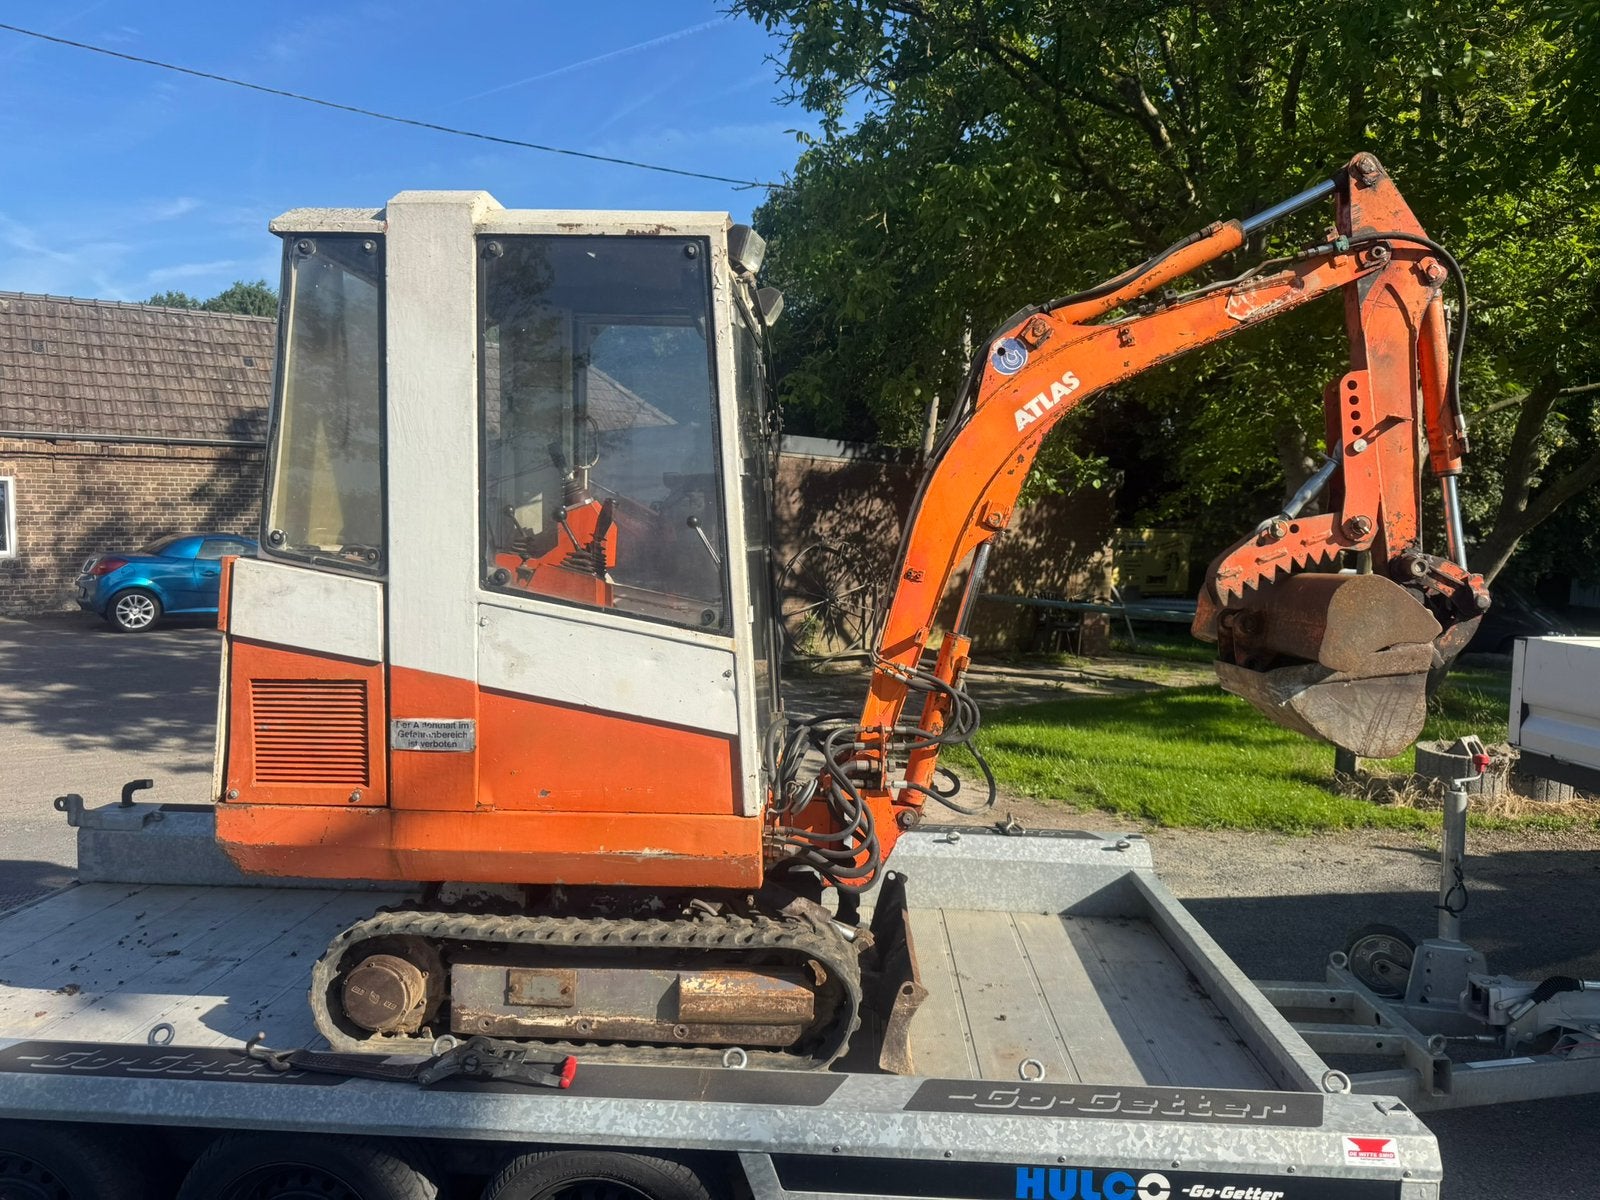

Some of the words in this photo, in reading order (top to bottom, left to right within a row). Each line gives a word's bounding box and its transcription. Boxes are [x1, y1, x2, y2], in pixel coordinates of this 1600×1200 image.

[1014, 370, 1081, 432] ATLAS
[458, 721, 470, 729] im
[420, 740, 457, 748] verboten
[1015, 1166, 1172, 1200] HULCO
